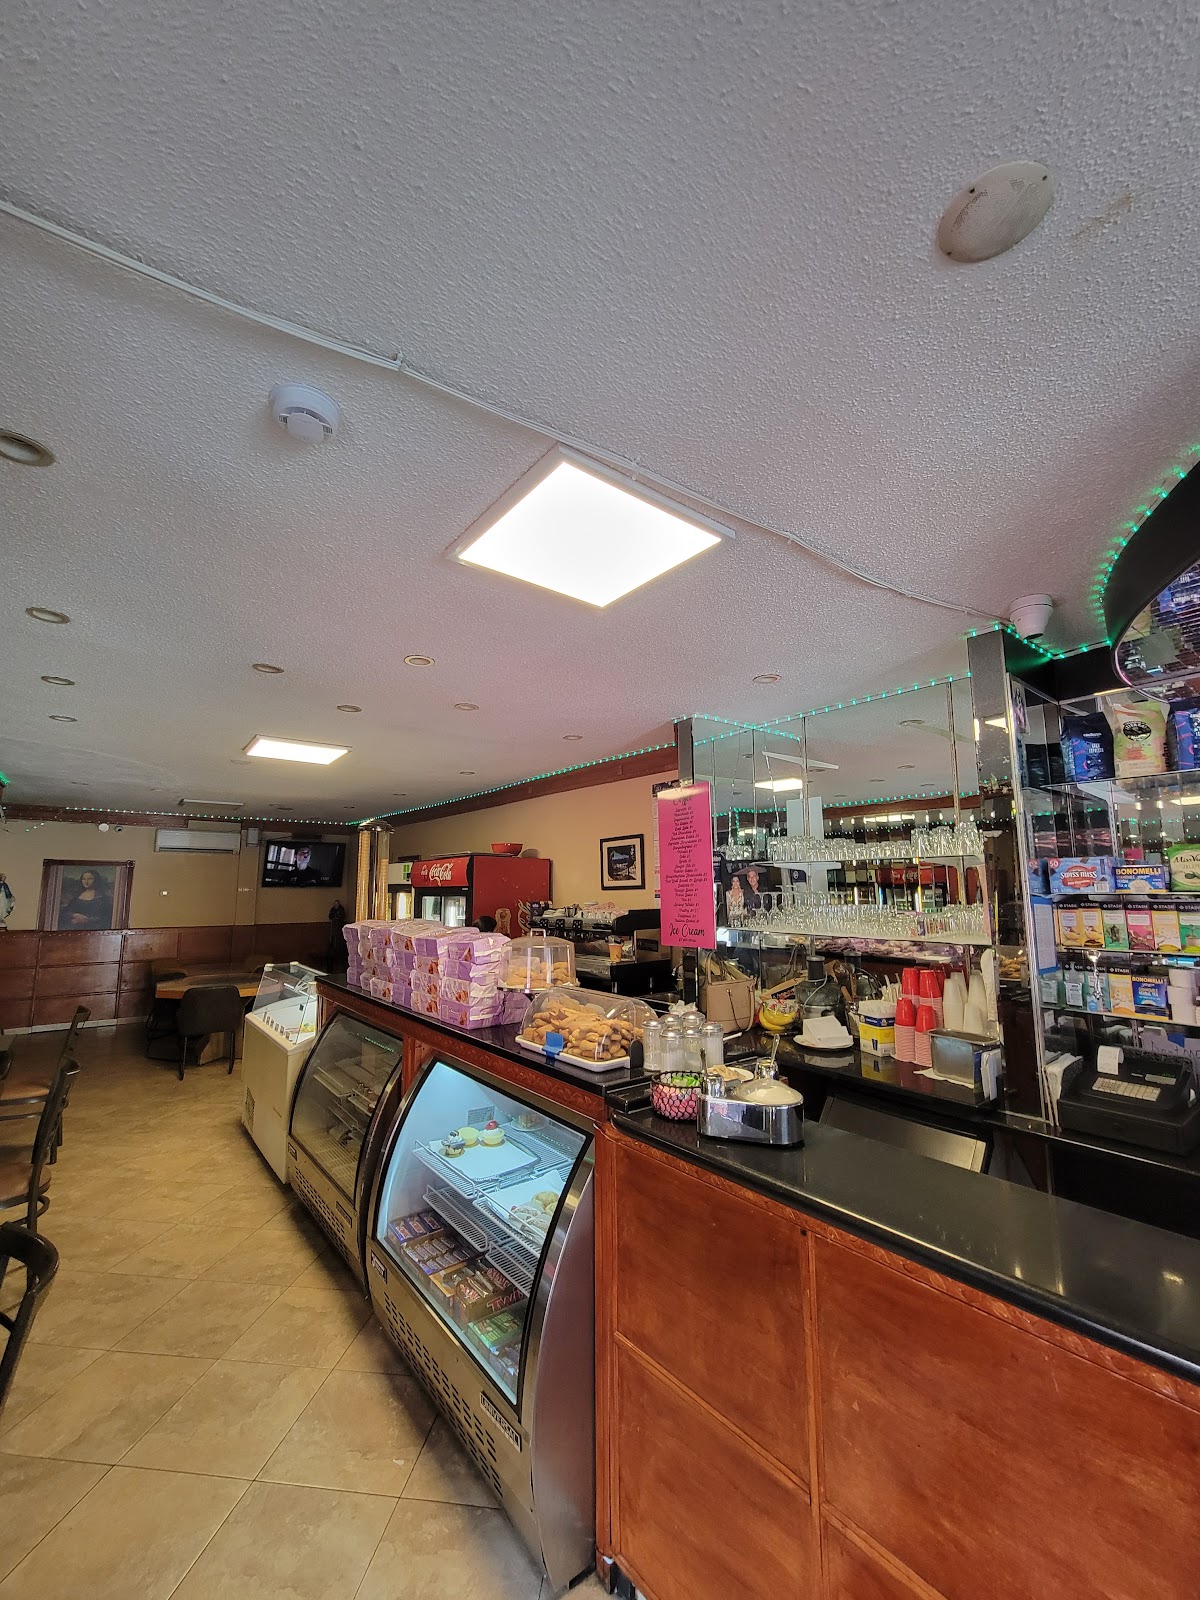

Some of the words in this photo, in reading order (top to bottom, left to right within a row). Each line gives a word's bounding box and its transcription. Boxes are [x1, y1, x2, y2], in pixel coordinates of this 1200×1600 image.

[1173, 856, 1192, 864] Miss
[429, 862, 454, 887] Coca-Cola
[1115, 867, 1161, 875] BONOMELLI
[669, 922, 679, 937] Ice
[681, 923, 705, 938] Cream
[1131, 976, 1164, 984] BONOMELLI
